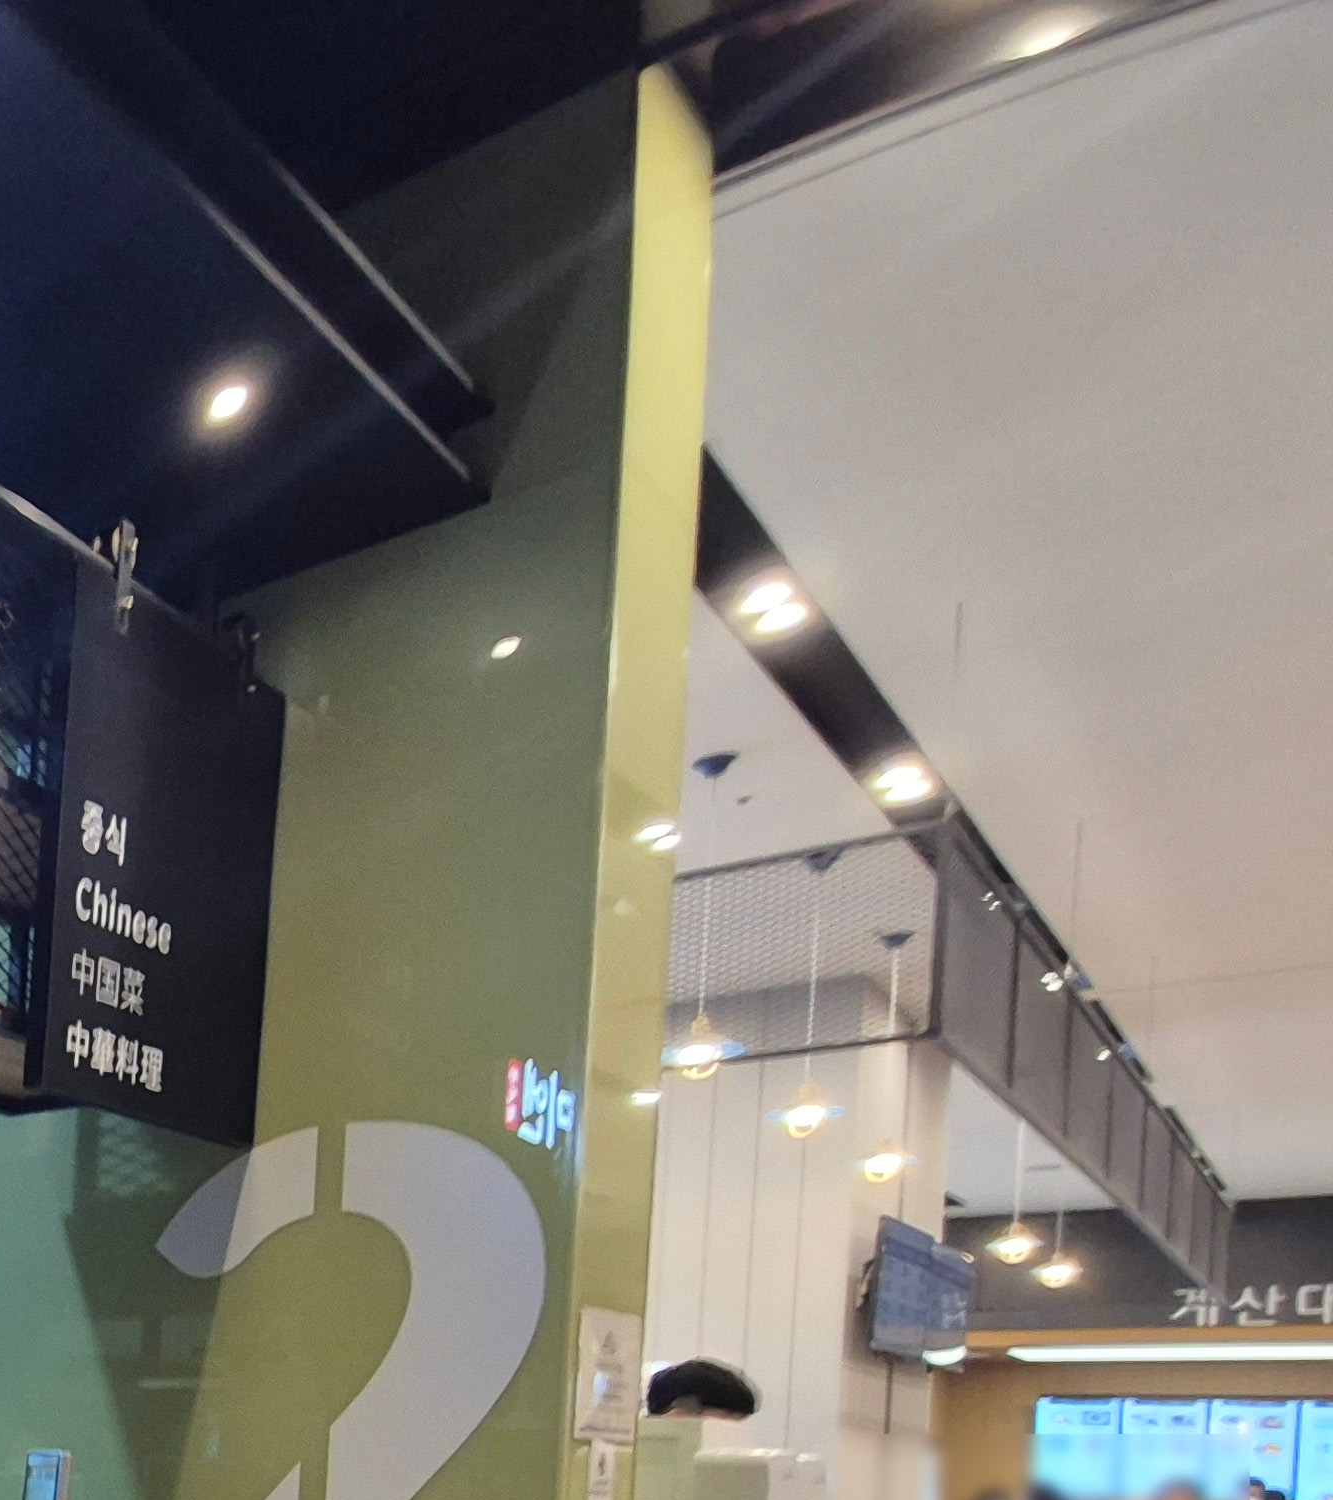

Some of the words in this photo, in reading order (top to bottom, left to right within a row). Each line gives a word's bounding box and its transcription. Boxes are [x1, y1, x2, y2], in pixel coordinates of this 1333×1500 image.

[81, 800, 127, 866] 중식
[76, 877, 172, 955] Chinese
[72, 948, 146, 1016] 中国菜
[66, 1019, 163, 1092] 中華料理
